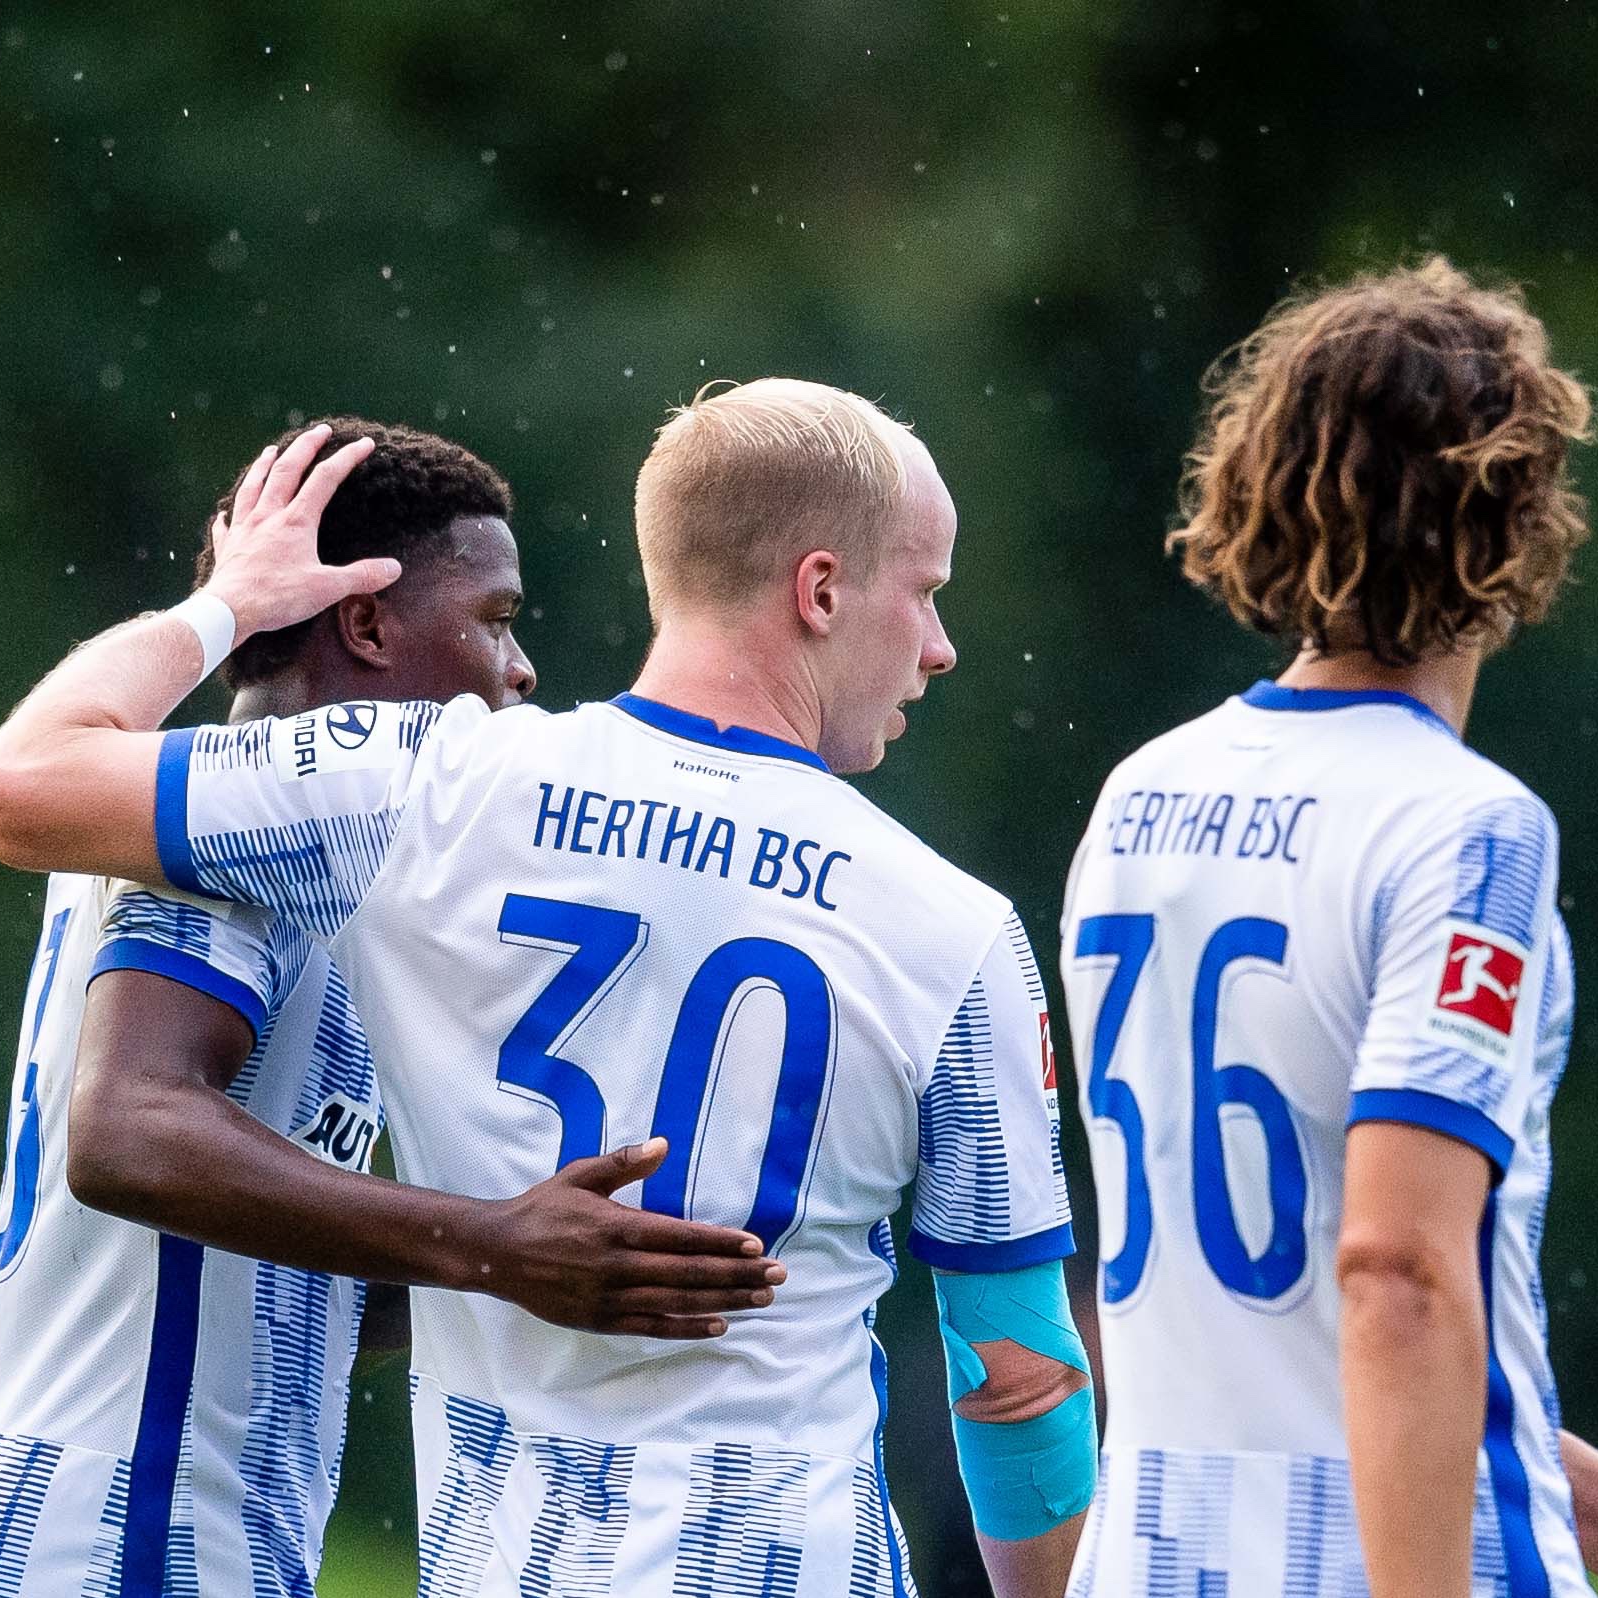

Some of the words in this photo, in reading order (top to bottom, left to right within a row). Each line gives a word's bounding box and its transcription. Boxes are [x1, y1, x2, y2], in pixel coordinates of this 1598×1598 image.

[673, 760, 741, 782] HaHoHe
[1236, 796, 1317, 863] BSC
[533, 783, 736, 878] HERTHA
[749, 827, 852, 911] BSC
[496, 893, 838, 1258] 30
[1074, 914, 1309, 1308] 36
